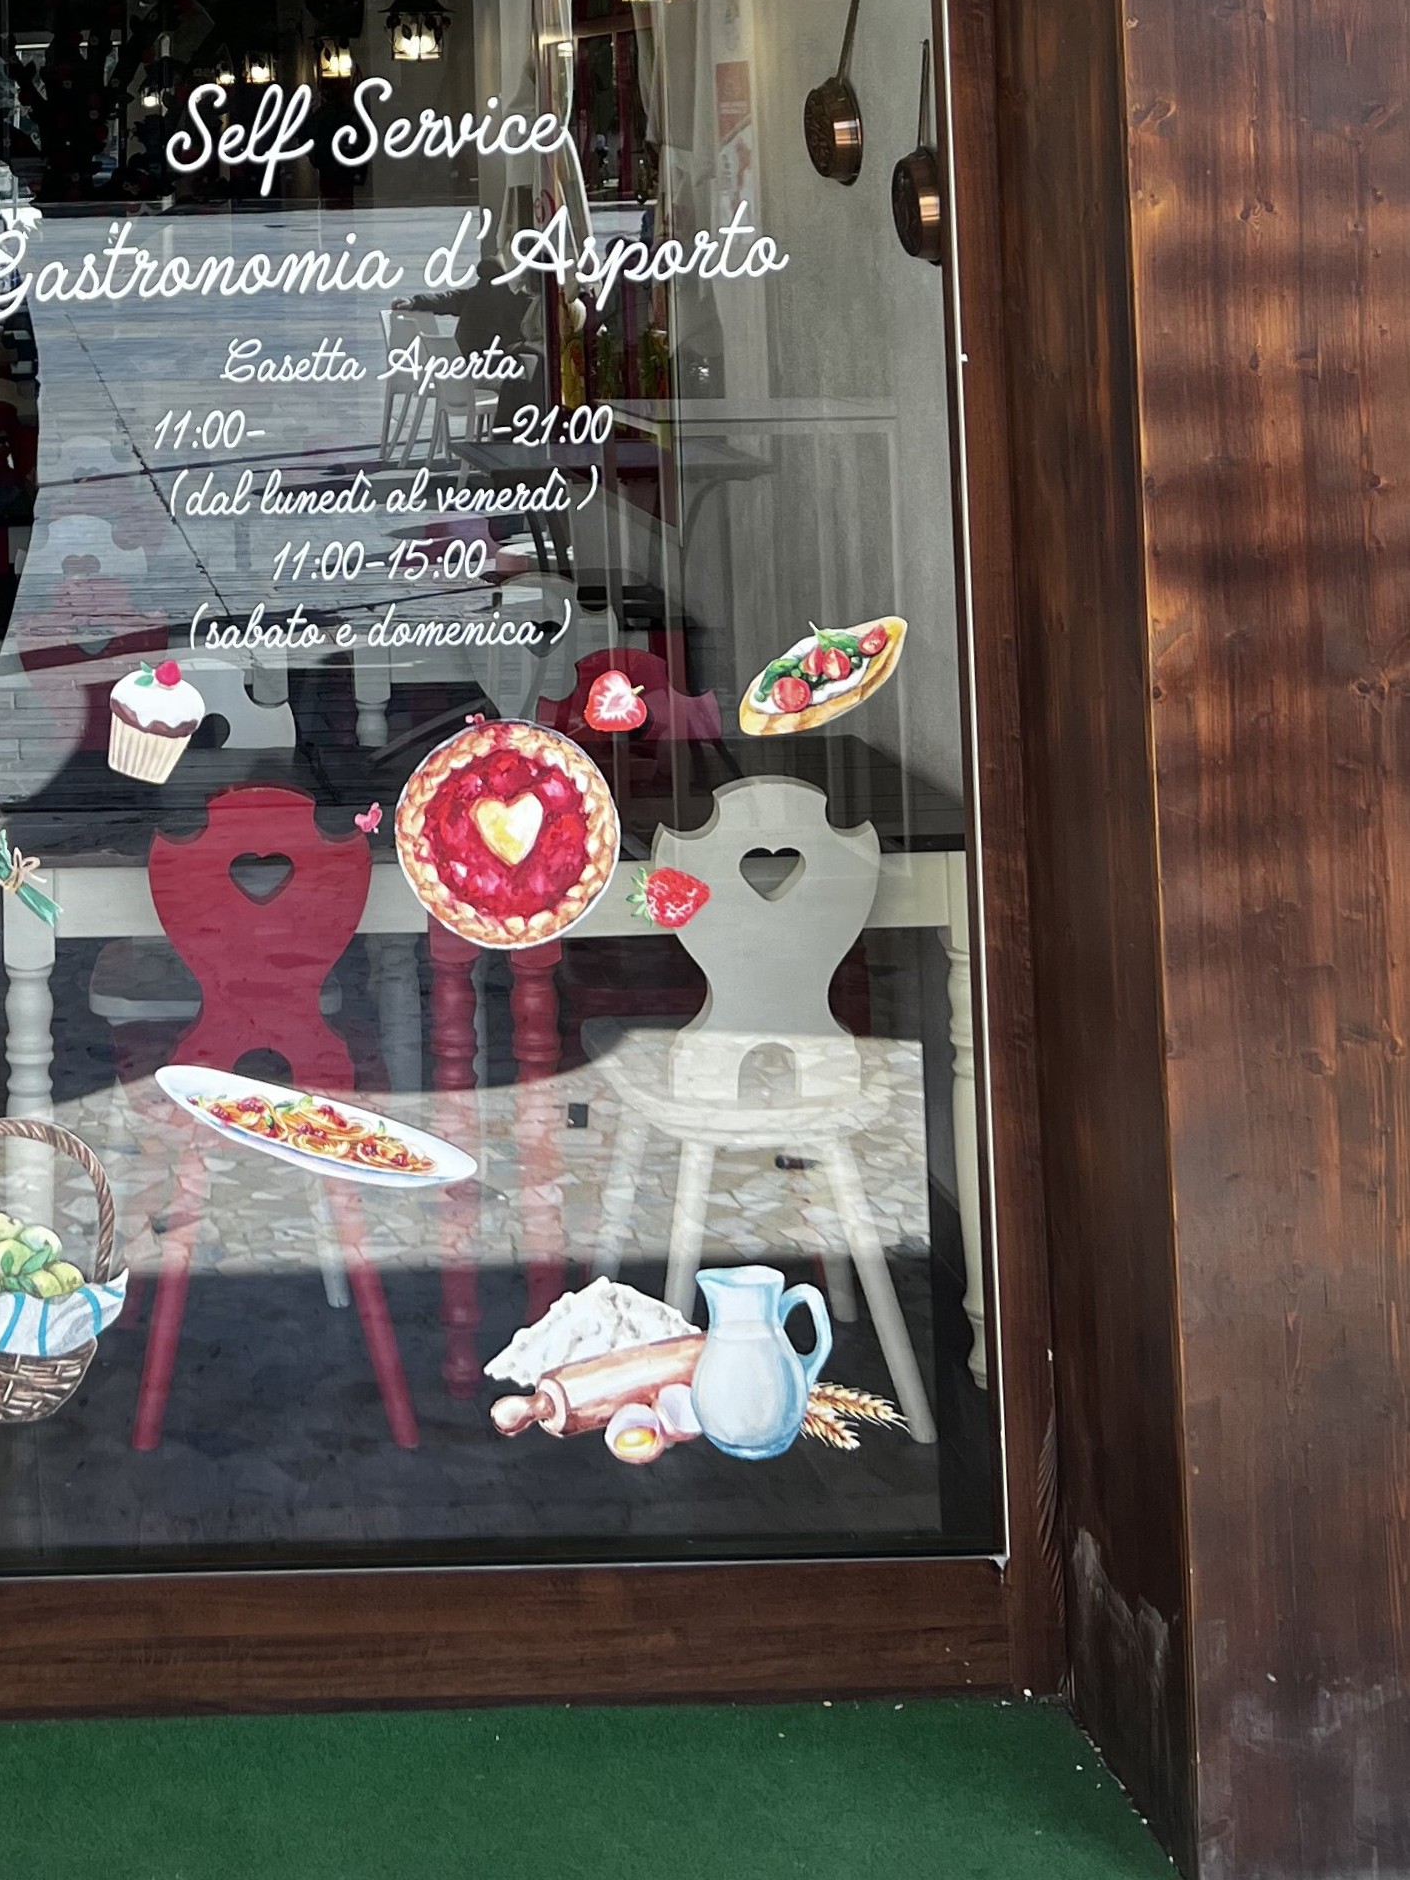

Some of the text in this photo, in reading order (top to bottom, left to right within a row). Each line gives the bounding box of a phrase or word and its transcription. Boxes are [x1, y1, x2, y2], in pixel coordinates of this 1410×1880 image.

[166, 77, 569, 196] Self Service
[219, 335, 524, 395] Casetta Aperta
[168, 469, 251, 517] (dal
[259, 469, 376, 515] lunedì
[386, 467, 429, 513] al
[189, 602, 326, 651] (sabato
[336, 621, 358, 647] e
